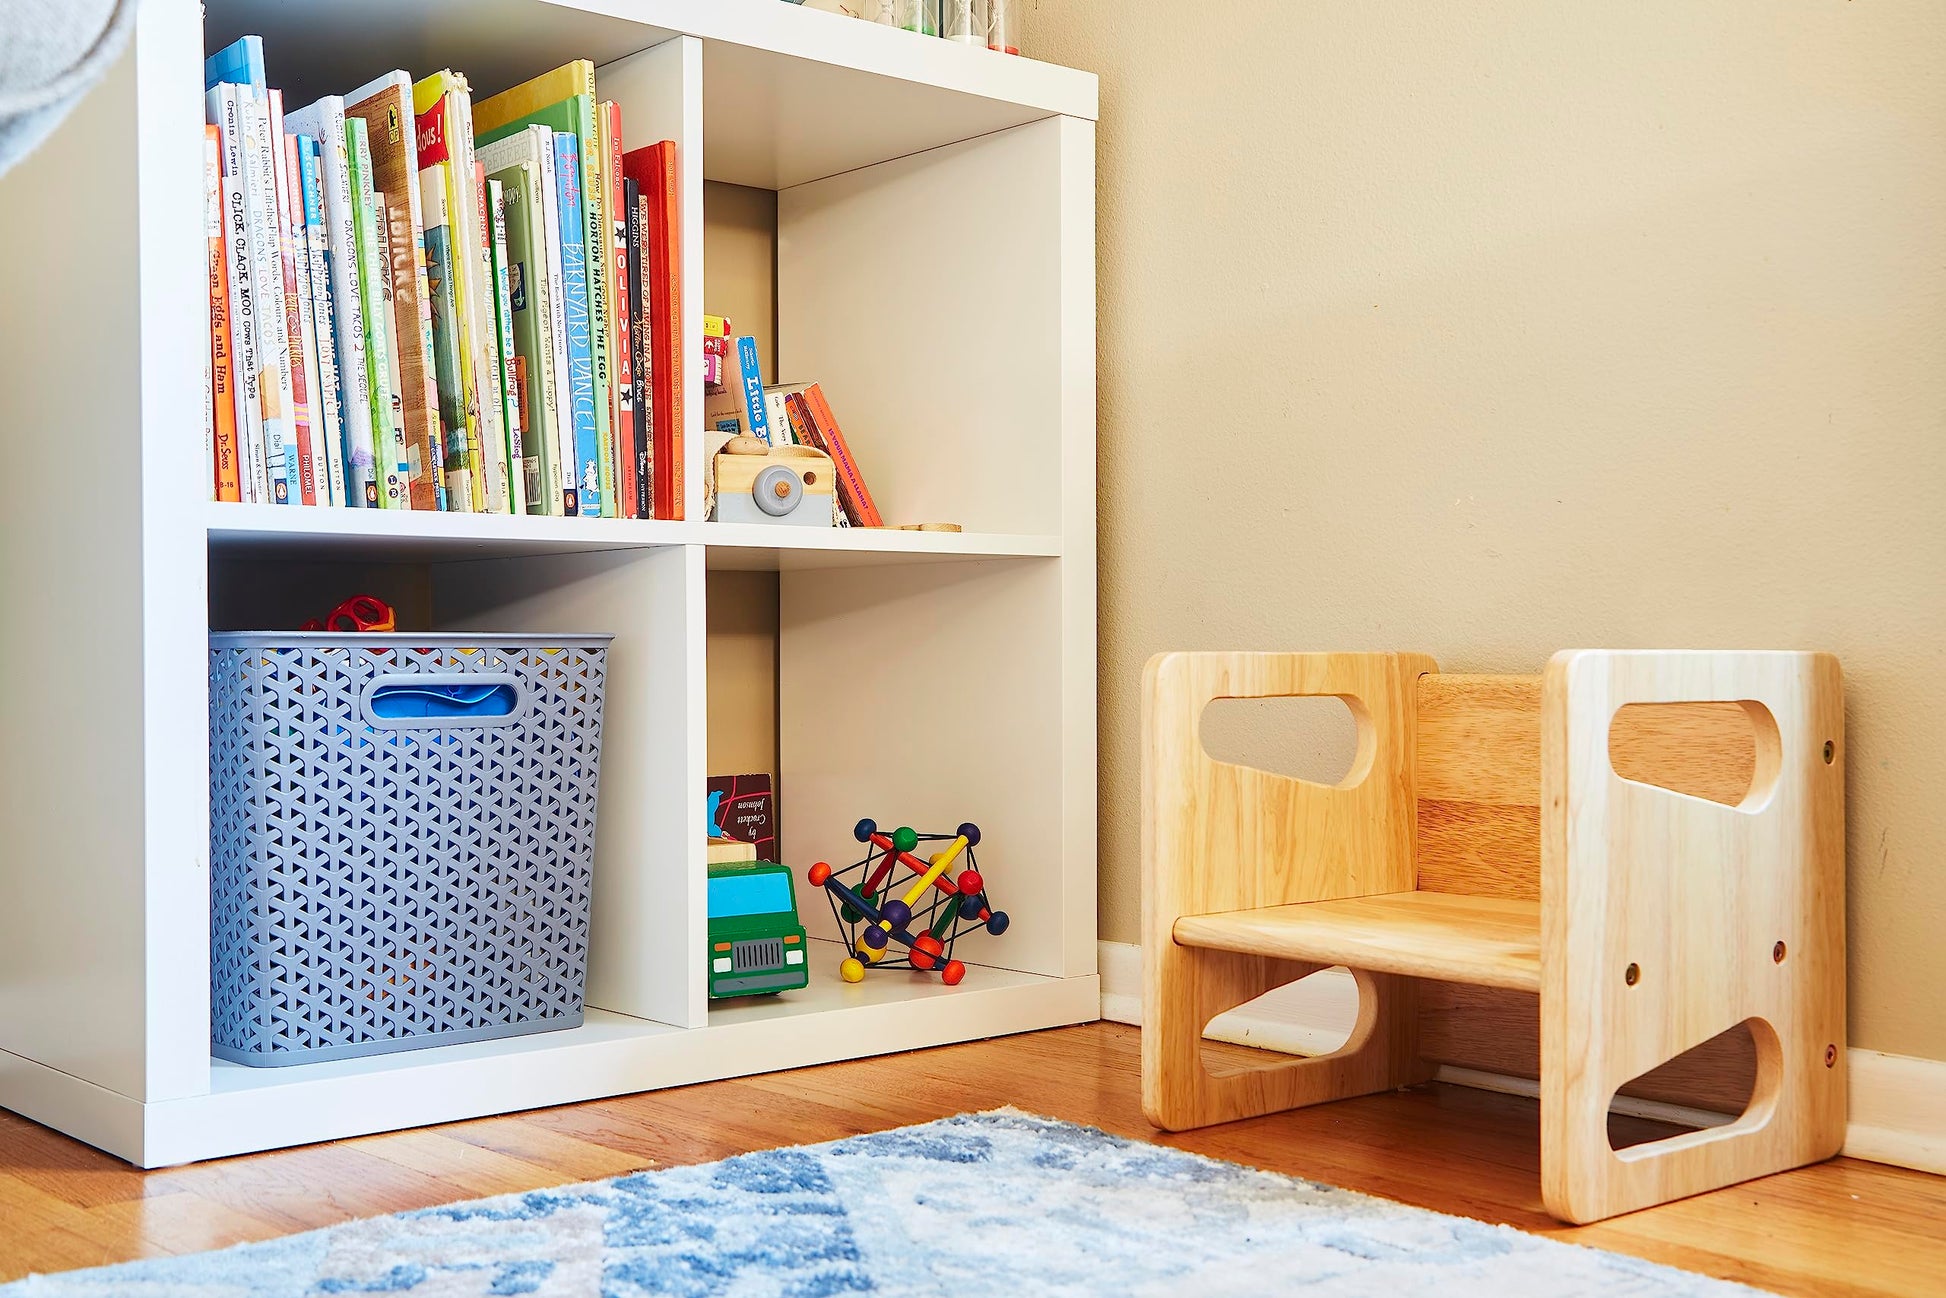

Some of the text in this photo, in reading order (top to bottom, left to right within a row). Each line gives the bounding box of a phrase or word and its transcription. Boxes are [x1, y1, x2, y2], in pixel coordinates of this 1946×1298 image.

[588, 72, 596, 103] YOLEN
[227, 100, 235, 136] Cronin
[258, 117, 267, 143] Peter
[416, 113, 442, 152] dous!
[230, 145, 238, 176] Lewin
[261, 146, 272, 184] Rabbit's
[359, 131, 372, 208] JERRY PINKNEY
[304, 154, 318, 220] SCHACHNER
[232, 192, 245, 235] CLICK,
[477, 182, 487, 242] SCHACHNER
[631, 206, 639, 248] HIGGINS
[640, 203, 648, 220] WE
[366, 225, 376, 247] THE
[589, 212, 600, 263] HORTON
[236, 238, 248, 284] CLACK,
[368, 252, 378, 284] THREE
[641, 255, 649, 287] TIRED
[253, 210, 274, 345] DRAGONS LOVE TACOS
[499, 267, 508, 292] Would
[240, 288, 251, 316] MOO
[274, 286, 284, 324] Colours
[345, 219, 368, 403] DRAGONS LOVE TACOS 2 THE SEQUEL
[500, 293, 508, 307] you
[592, 269, 604, 323] HATCHES
[642, 289, 649, 304] OF
[210, 250, 226, 394] Green Eggs and Ham
[541, 300, 549, 332] Pigeon
[617, 254, 630, 375] OLIVIA
[243, 321, 251, 345] Cows
[278, 326, 286, 344] and
[376, 323, 387, 360] GOATS
[505, 337, 512, 348] be
[562, 243, 596, 431] BARNYARD DANCE!
[596, 328, 605, 350] THE
[644, 343, 651, 354] IN
[245, 348, 254, 371] That
[288, 335, 303, 368] Pickles
[544, 336, 552, 365] Wants
[645, 356, 651, 364] A
[280, 347, 288, 391] Numbers
[379, 364, 388, 400] GRUFF
[598, 356, 607, 379] EGG
[248, 374, 256, 399] Type
[546, 380, 556, 412] Puppy!
[636, 379, 645, 402] Bruce
[747, 376, 768, 438] Little B
[218, 433, 231, 471] Dr. Seuss
[273, 434, 282, 450] Dial
[288, 454, 297, 485] WARNE
[302, 454, 313, 495] PHILOMEL
[317, 456, 325, 490] DUTTON
[639, 451, 647, 476] Disney
[828, 428, 835, 437] IS
[832, 436, 843, 456] YOUR
[841, 456, 854, 479] MAMA
[853, 483, 869, 510] LLAMA?
[737, 797, 766, 812] Johnson
[737, 813, 766, 826] Crockett
[748, 826, 757, 840] by
